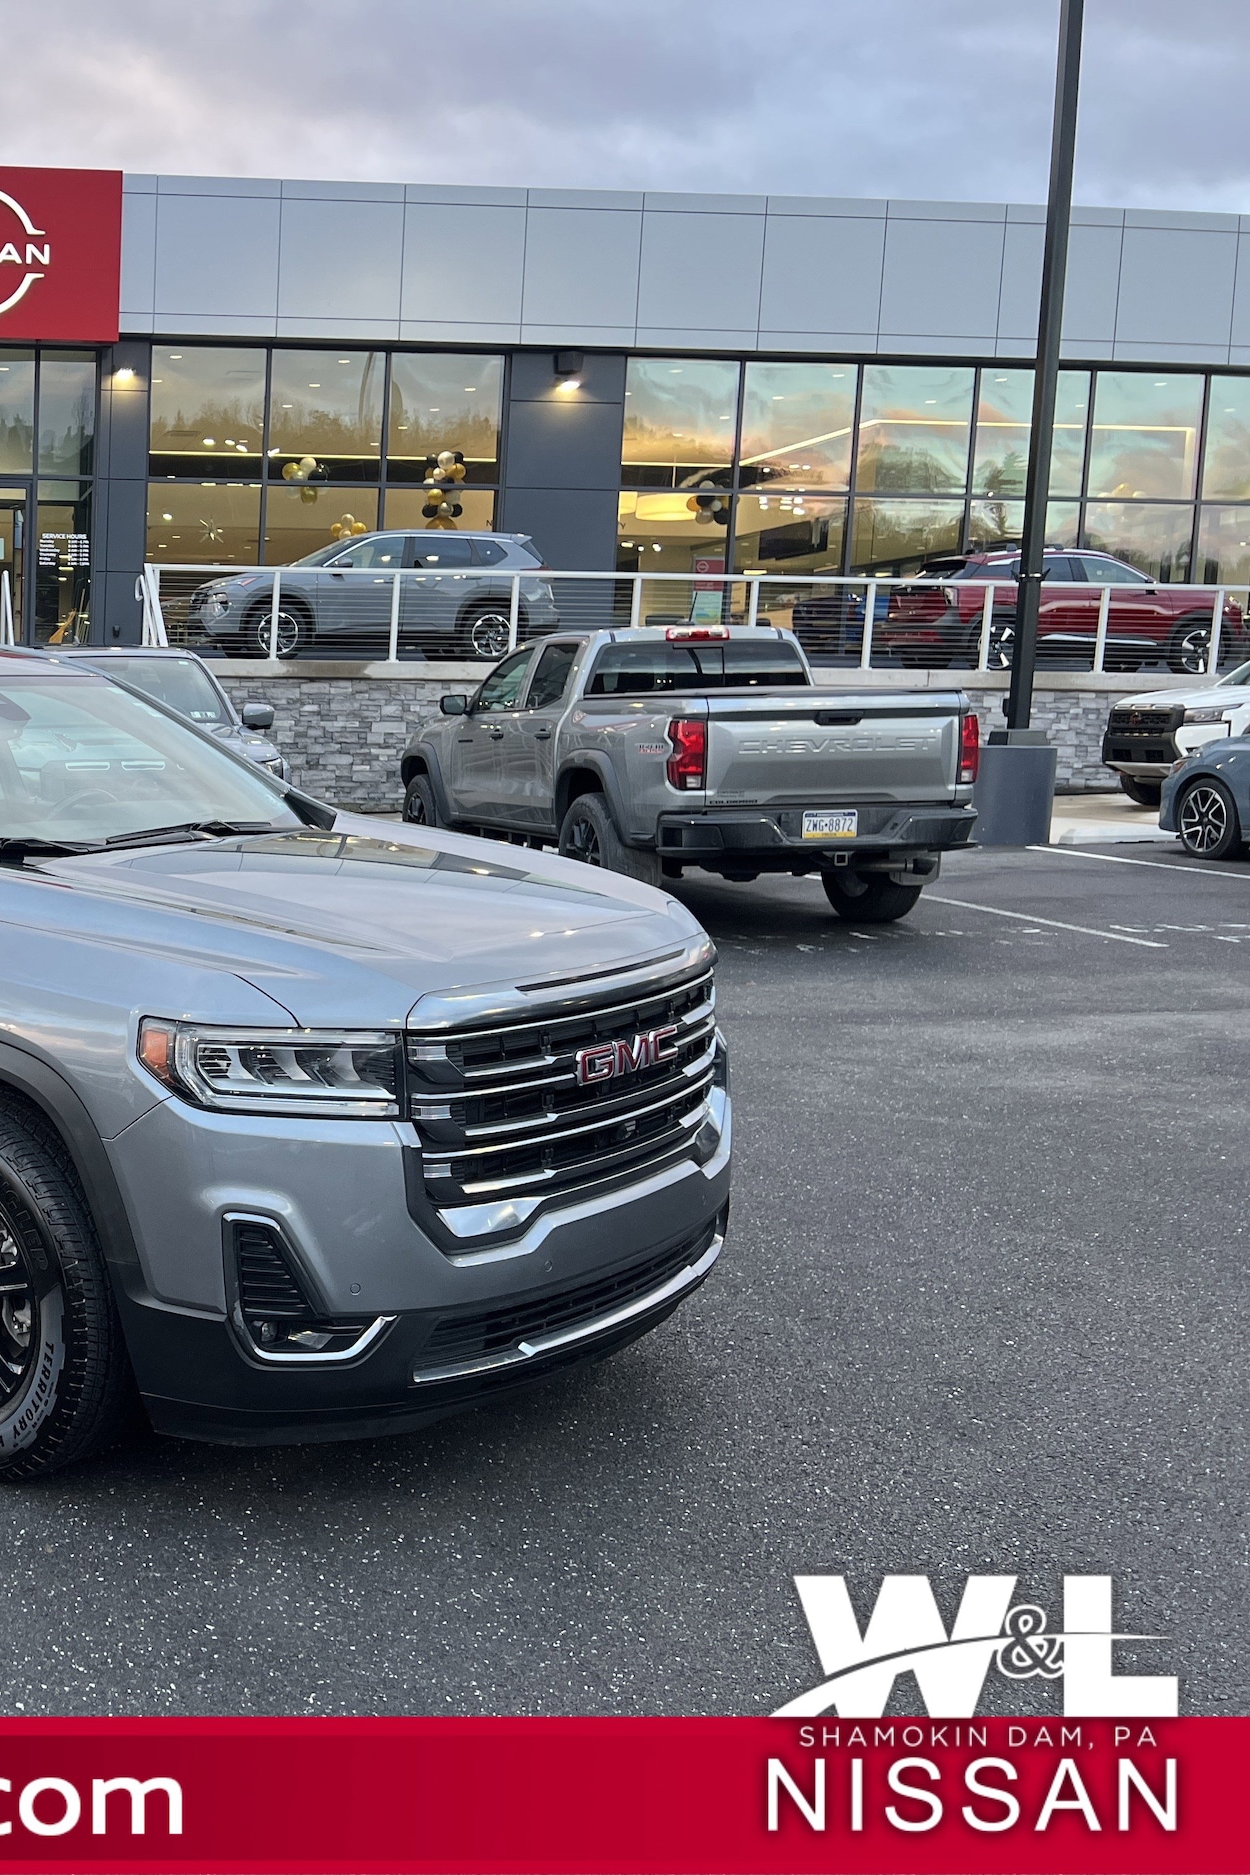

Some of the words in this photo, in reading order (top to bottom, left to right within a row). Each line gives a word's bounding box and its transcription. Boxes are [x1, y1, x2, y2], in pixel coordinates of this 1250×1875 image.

[738, 737, 937, 754] CHEVROLET
[575, 1025, 678, 1086] GMC
[12, 1341, 55, 1439] TERRITORY
